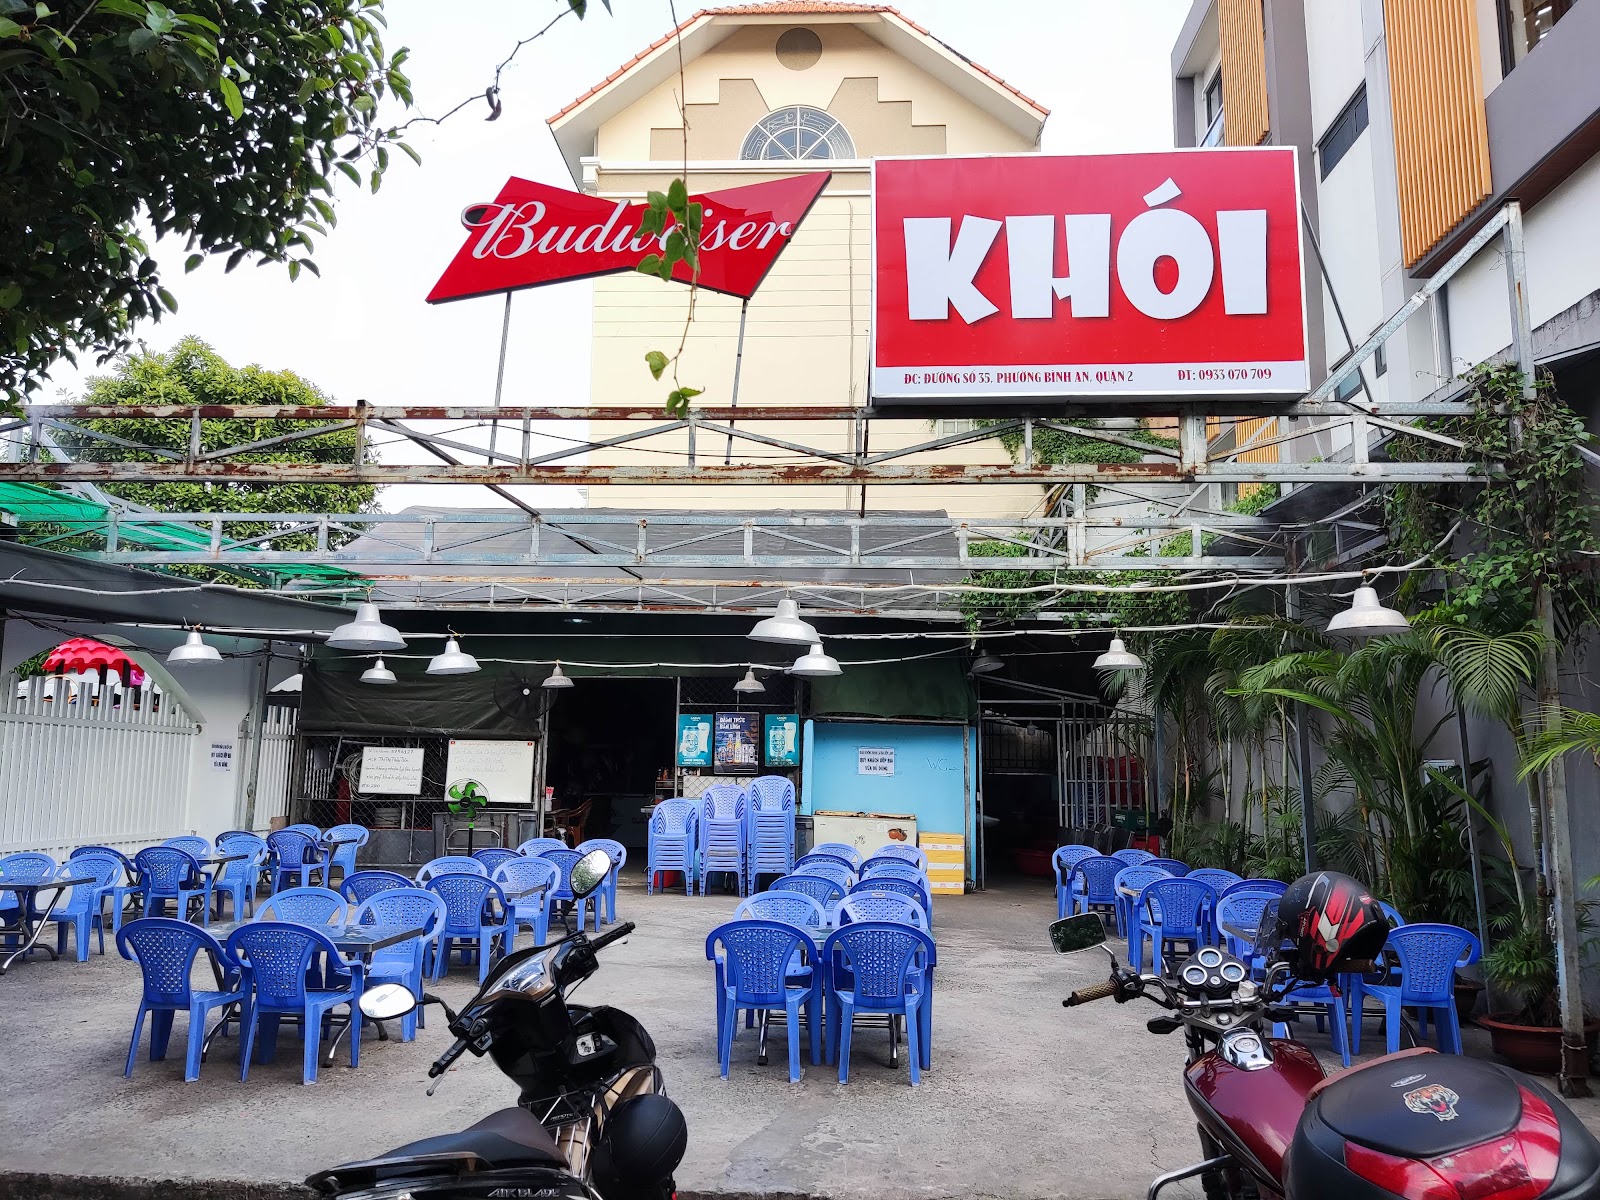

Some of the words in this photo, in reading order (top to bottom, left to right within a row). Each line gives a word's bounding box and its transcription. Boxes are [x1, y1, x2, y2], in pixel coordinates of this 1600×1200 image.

[462, 199, 792, 260] Budweser
[903, 176, 1268, 325] KHÓI
[904, 373, 921, 385] ĐC:
[924, 370, 961, 384] ĐƯỜNG
[962, 368, 977, 384] SỐ
[996, 370, 1042, 383] PHƯỜNG
[1044, 369, 1072, 383] BÌNH
[1095, 369, 1125, 384] QUẬN
[1127, 370, 1135, 382] 2
[1177, 369, 1196, 381] ĐT:
[1198, 368, 1226, 381] 0933
[1227, 368, 1248, 380] 070
[1250, 367, 1272, 380] 709
[517, 1188, 561, 1198] BLADE
